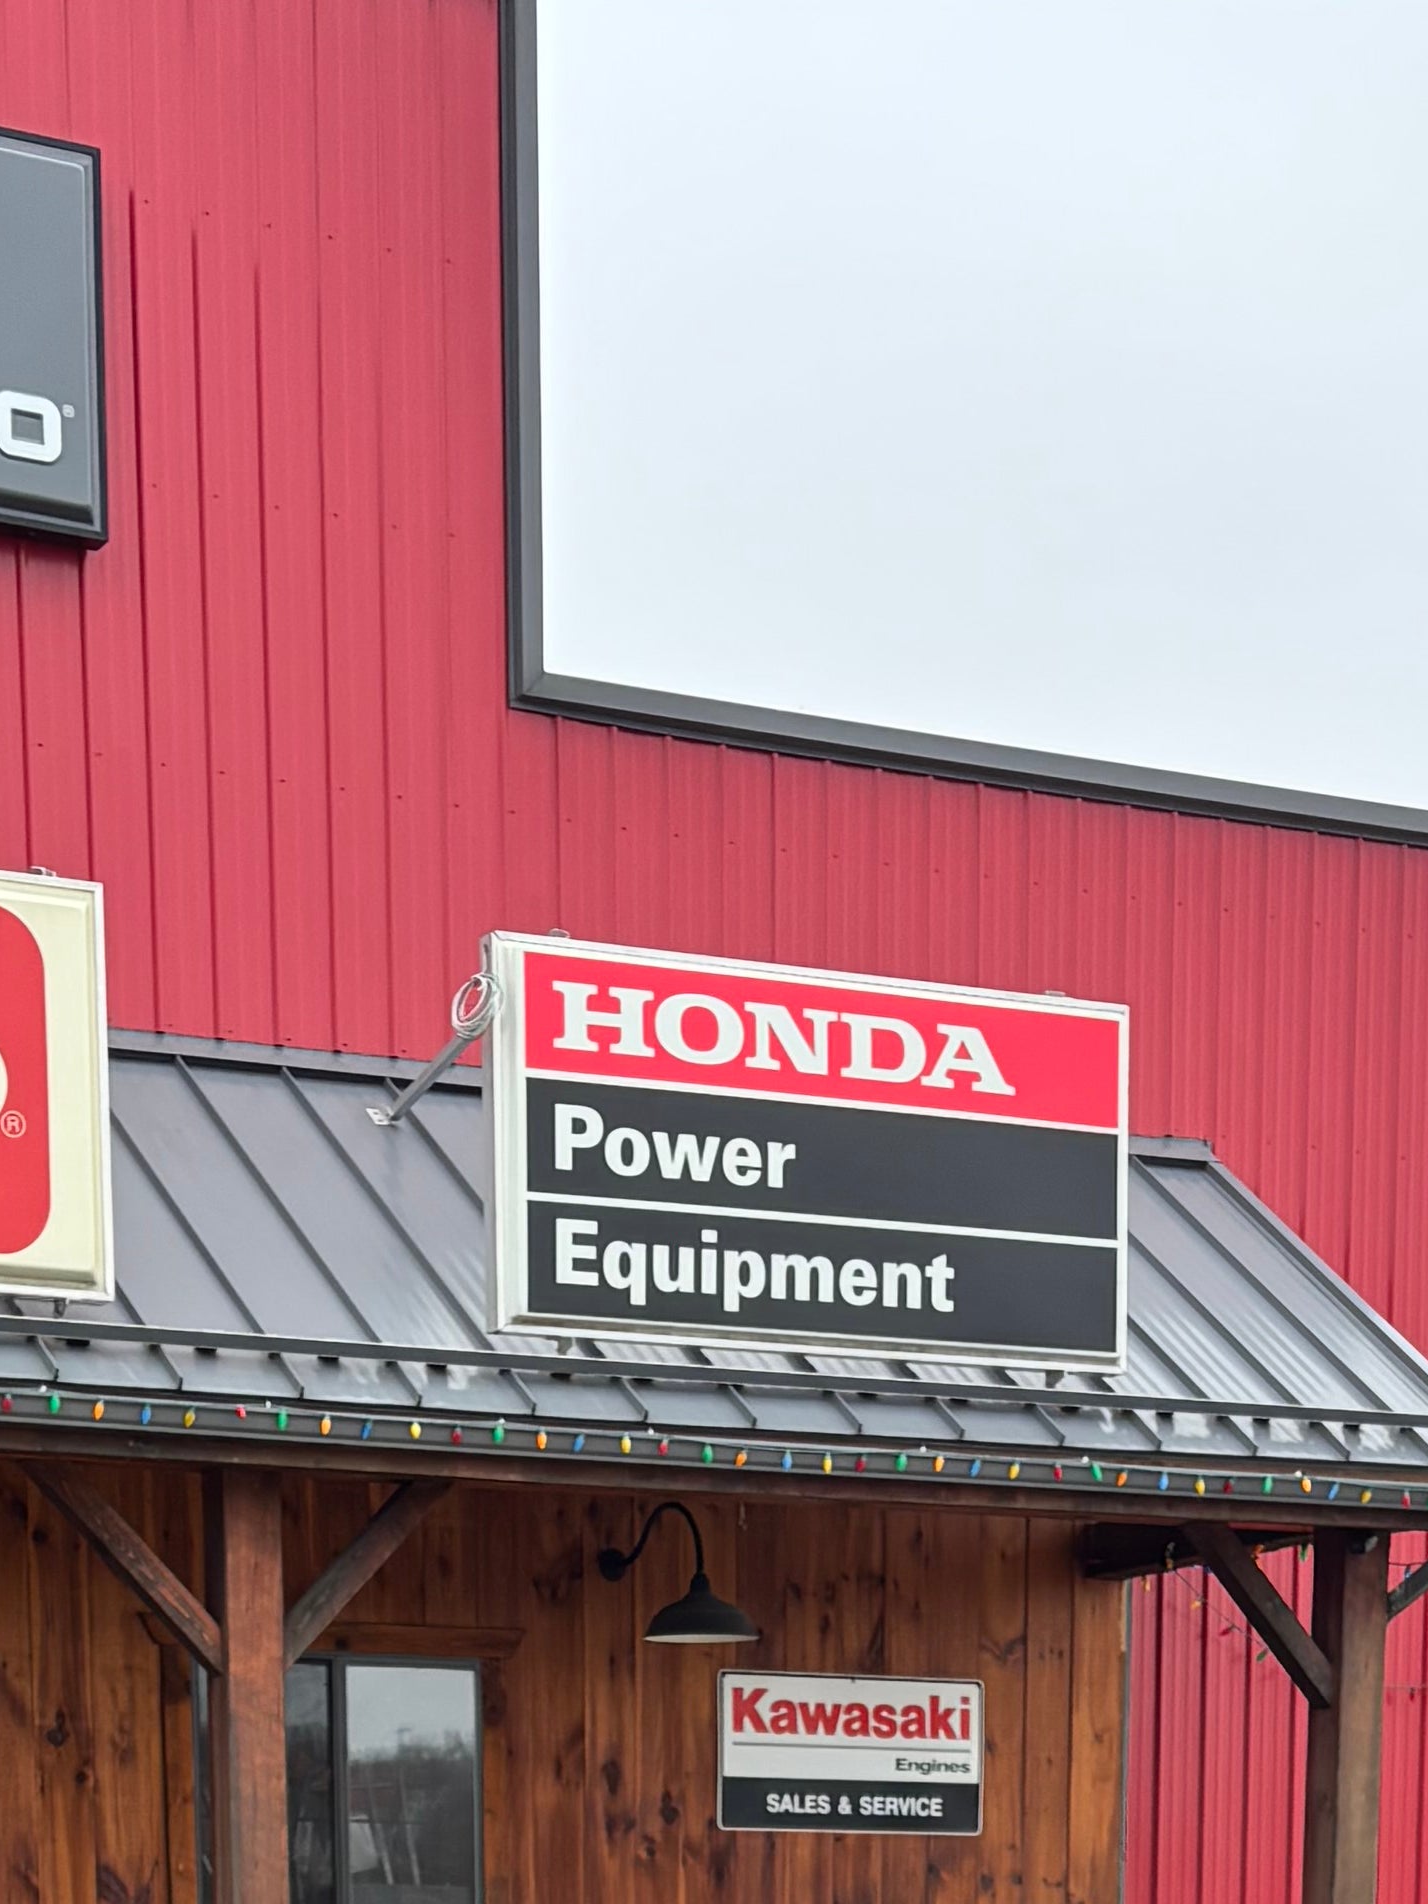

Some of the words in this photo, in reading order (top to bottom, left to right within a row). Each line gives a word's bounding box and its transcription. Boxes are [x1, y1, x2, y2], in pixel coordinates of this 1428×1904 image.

[552, 980, 1015, 1096] HONDA
[554, 1103, 796, 1188] Power
[555, 1218, 955, 1312] Equipment
[731, 1687, 970, 1740] Kawasaki
[895, 1757, 971, 1775] Engines
[766, 1793, 831, 1815] SALES
[837, 1796, 852, 1815] &
[859, 1796, 943, 1817] SERVICE
